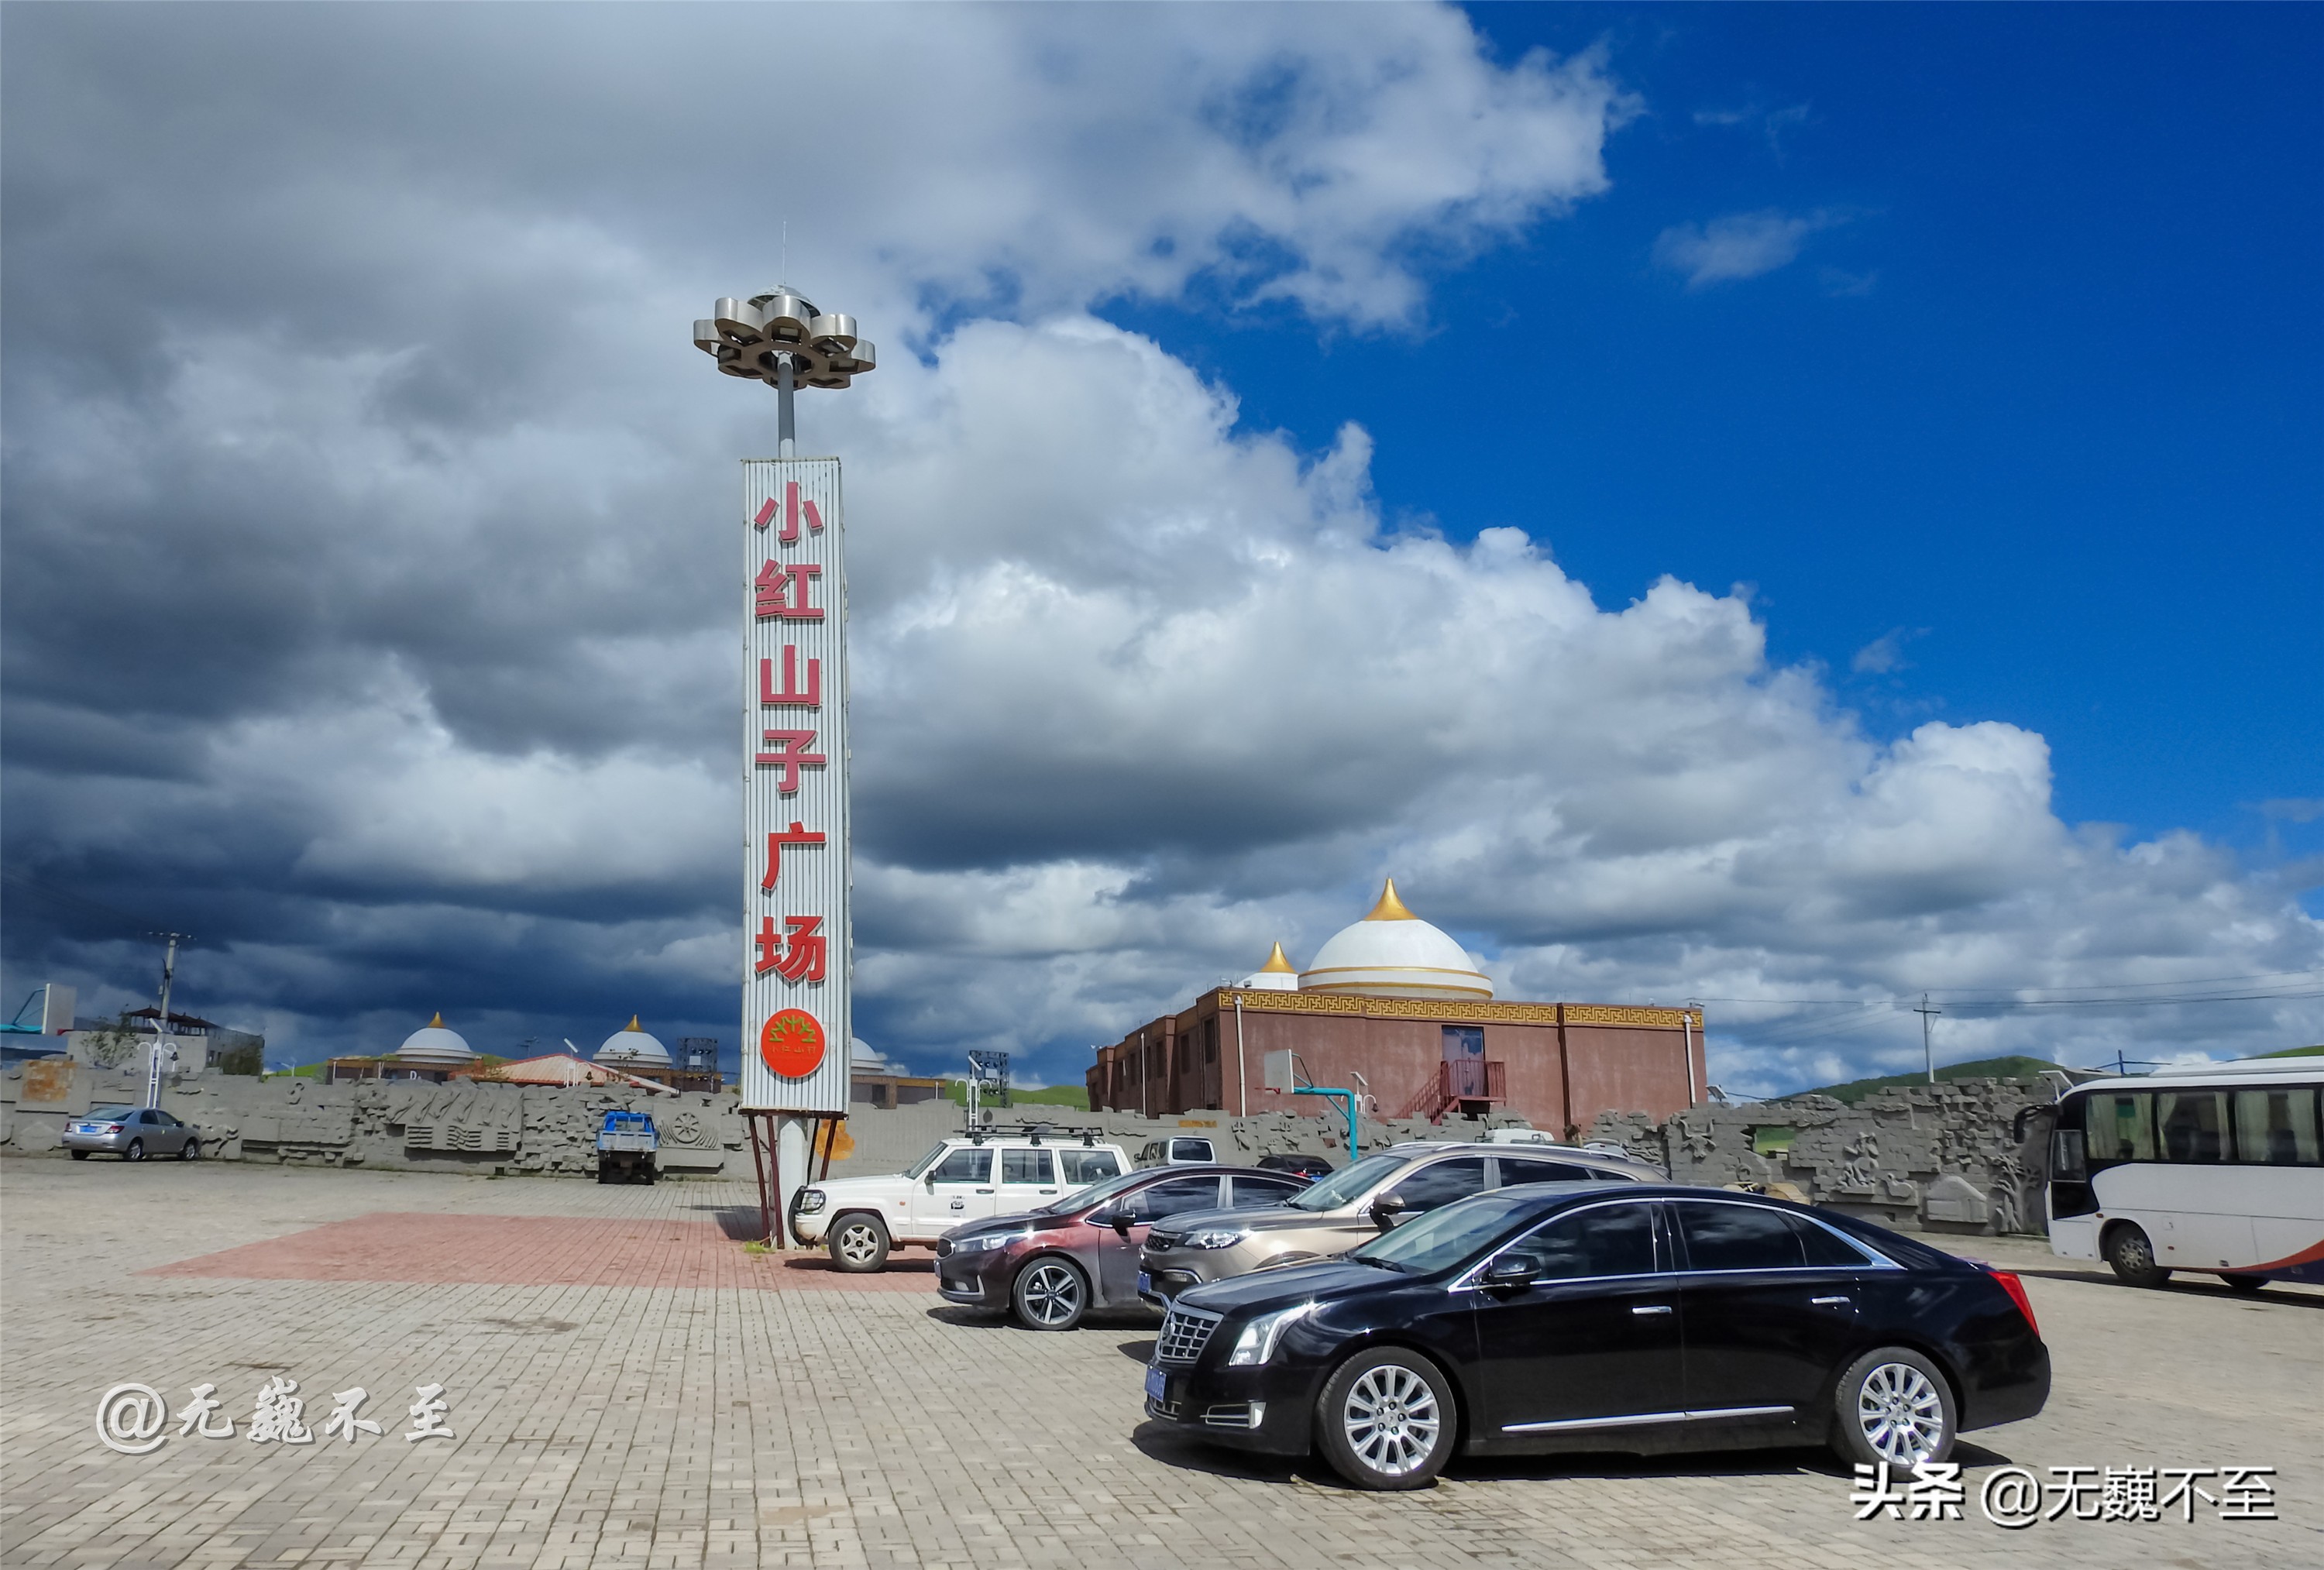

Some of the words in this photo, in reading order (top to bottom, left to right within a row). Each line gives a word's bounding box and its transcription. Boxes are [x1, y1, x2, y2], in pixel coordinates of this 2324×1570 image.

[754, 480, 827, 984] 小红山子广场
